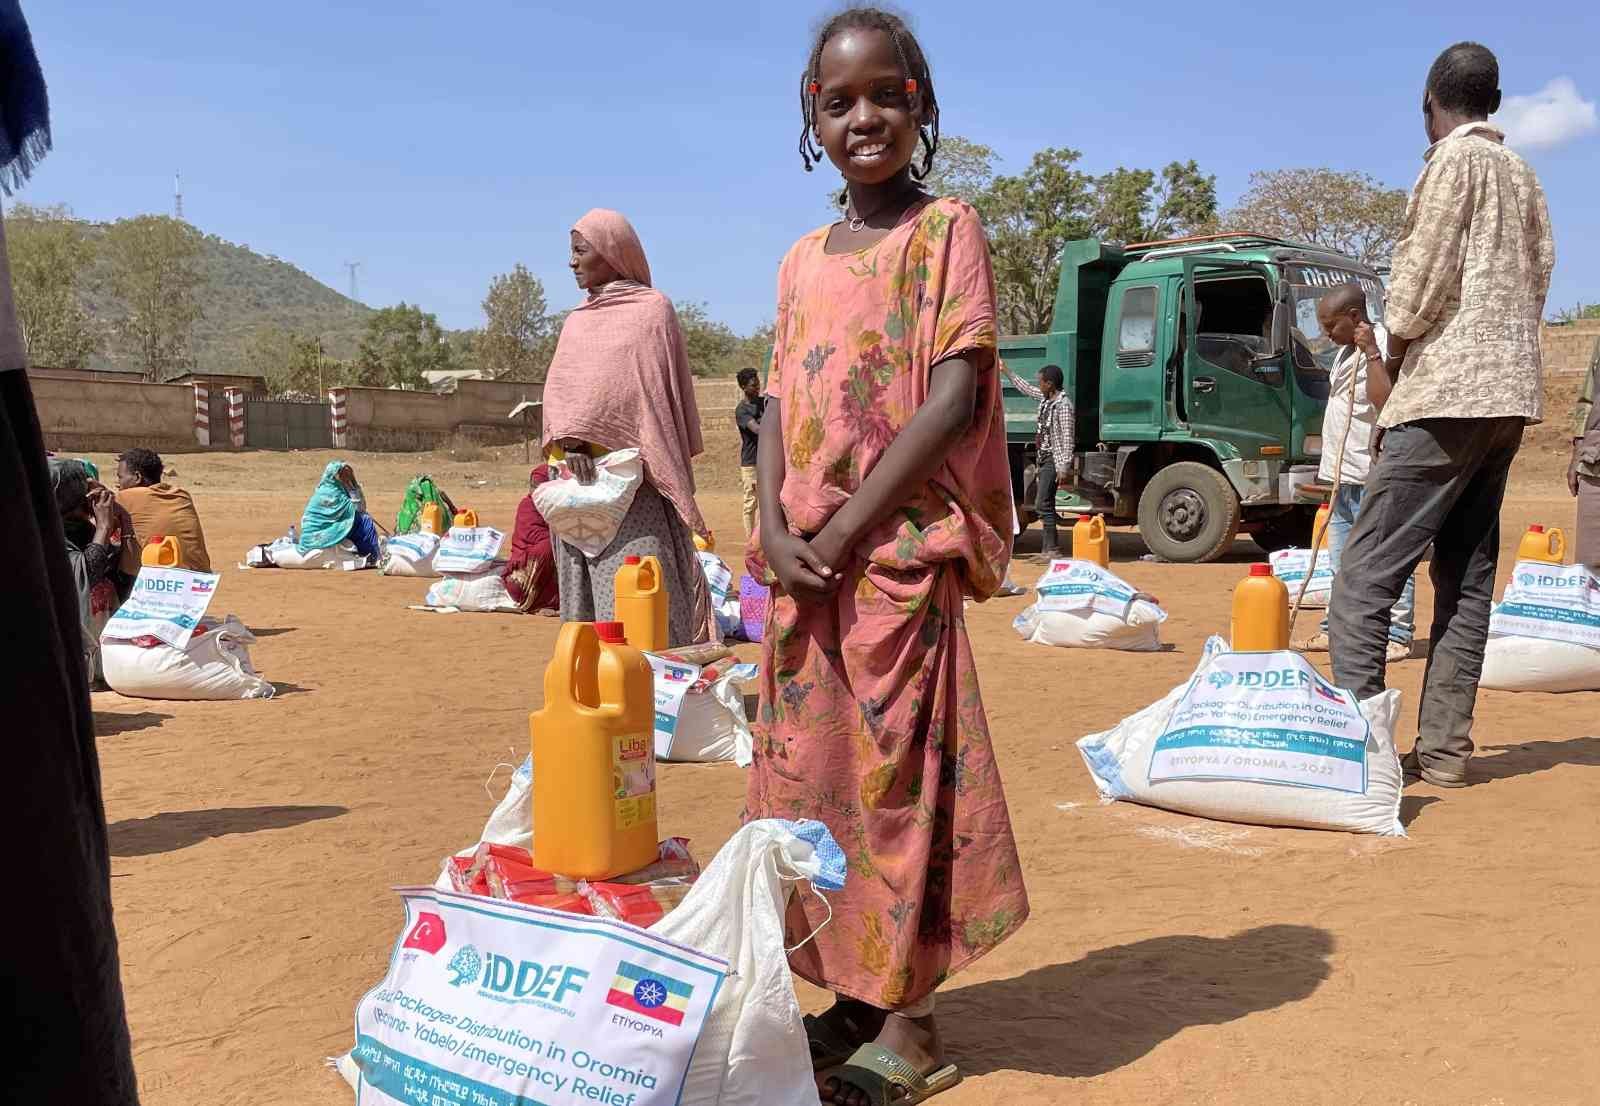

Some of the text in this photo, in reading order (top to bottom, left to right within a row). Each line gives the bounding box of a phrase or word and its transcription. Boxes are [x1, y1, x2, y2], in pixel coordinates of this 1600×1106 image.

[1317, 716, 1348, 729] Relief
[1233, 756, 1288, 770] OROMIA
[392, 991, 458, 1025] Packages
[456, 1015, 542, 1055] Distribution
[546, 1041, 566, 1062] in
[571, 1050, 657, 1090] Oromia
[571, 1077, 637, 1106] Relief
